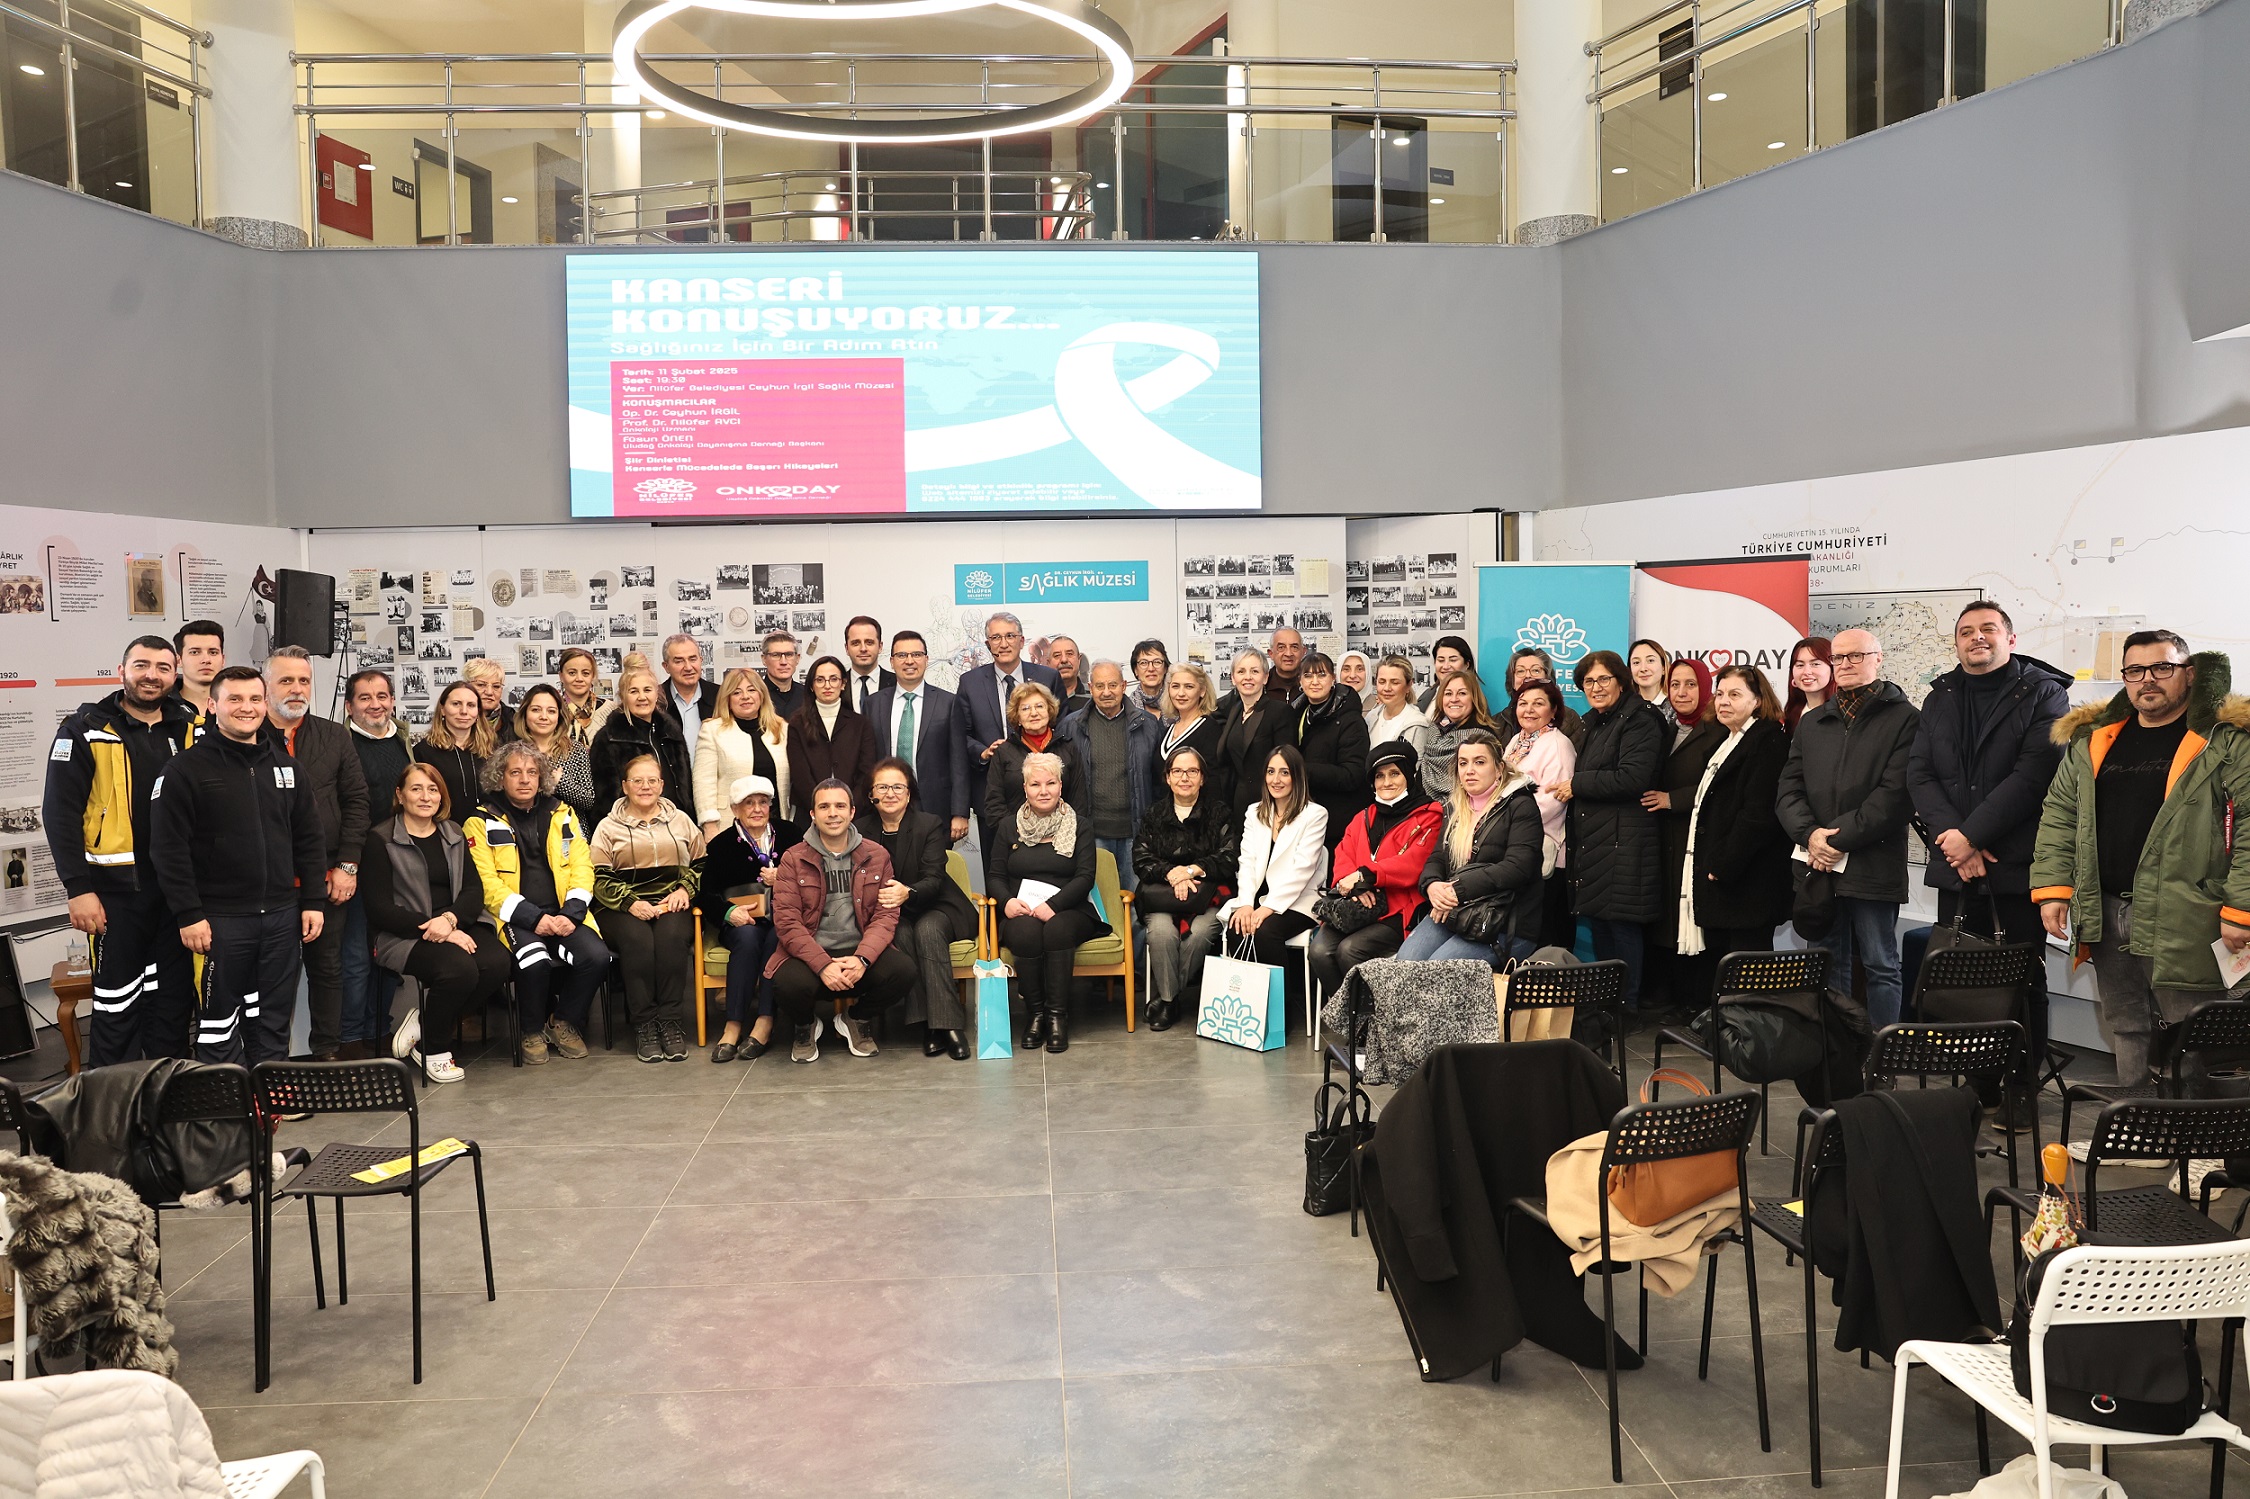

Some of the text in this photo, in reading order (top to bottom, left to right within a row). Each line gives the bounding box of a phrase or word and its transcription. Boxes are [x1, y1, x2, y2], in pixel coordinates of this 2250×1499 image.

[394, 180, 404, 192] WC
[611, 270, 844, 303] KANSERİ
[611, 305, 1061, 338] KONUŞUYORUZ...
[610, 337, 939, 356] Sağlığınız İçin Bir Adım Atın
[622, 367, 739, 377] Tarih: 11 Şubat 2025
[622, 377, 652, 385] Saat:
[689, 384, 745, 392] Belediyesi
[748, 383, 790, 391] Ceyhun
[793, 382, 815, 391] İrgil
[817, 382, 852, 391] Sağlık
[622, 398, 717, 407] KONUŞMACILAR
[622, 409, 641, 418] Op.
[662, 408, 707, 416] Ceyhun
[711, 407, 741, 415] İRGİL
[622, 419, 649, 427] Prof.
[670, 418, 711, 426] Nilüfer
[714, 417, 741, 425] AVCI
[661, 434, 694, 442] ÖNEN
[697, 441, 748, 449] Dayanışma
[624, 456, 692, 465] Şiir Dinletisi
[624, 462, 839, 473] Kanserle Mücadelede Başarı Hikayeleri
[1762, 530, 1816, 540] CUMHURİYETİN
[1830, 526, 1860, 535] YILINDA
[1742, 533, 1887, 555] TÜRKİYE CUMHURİYETİ
[1083, 571, 1136, 587] MÜZESİ
